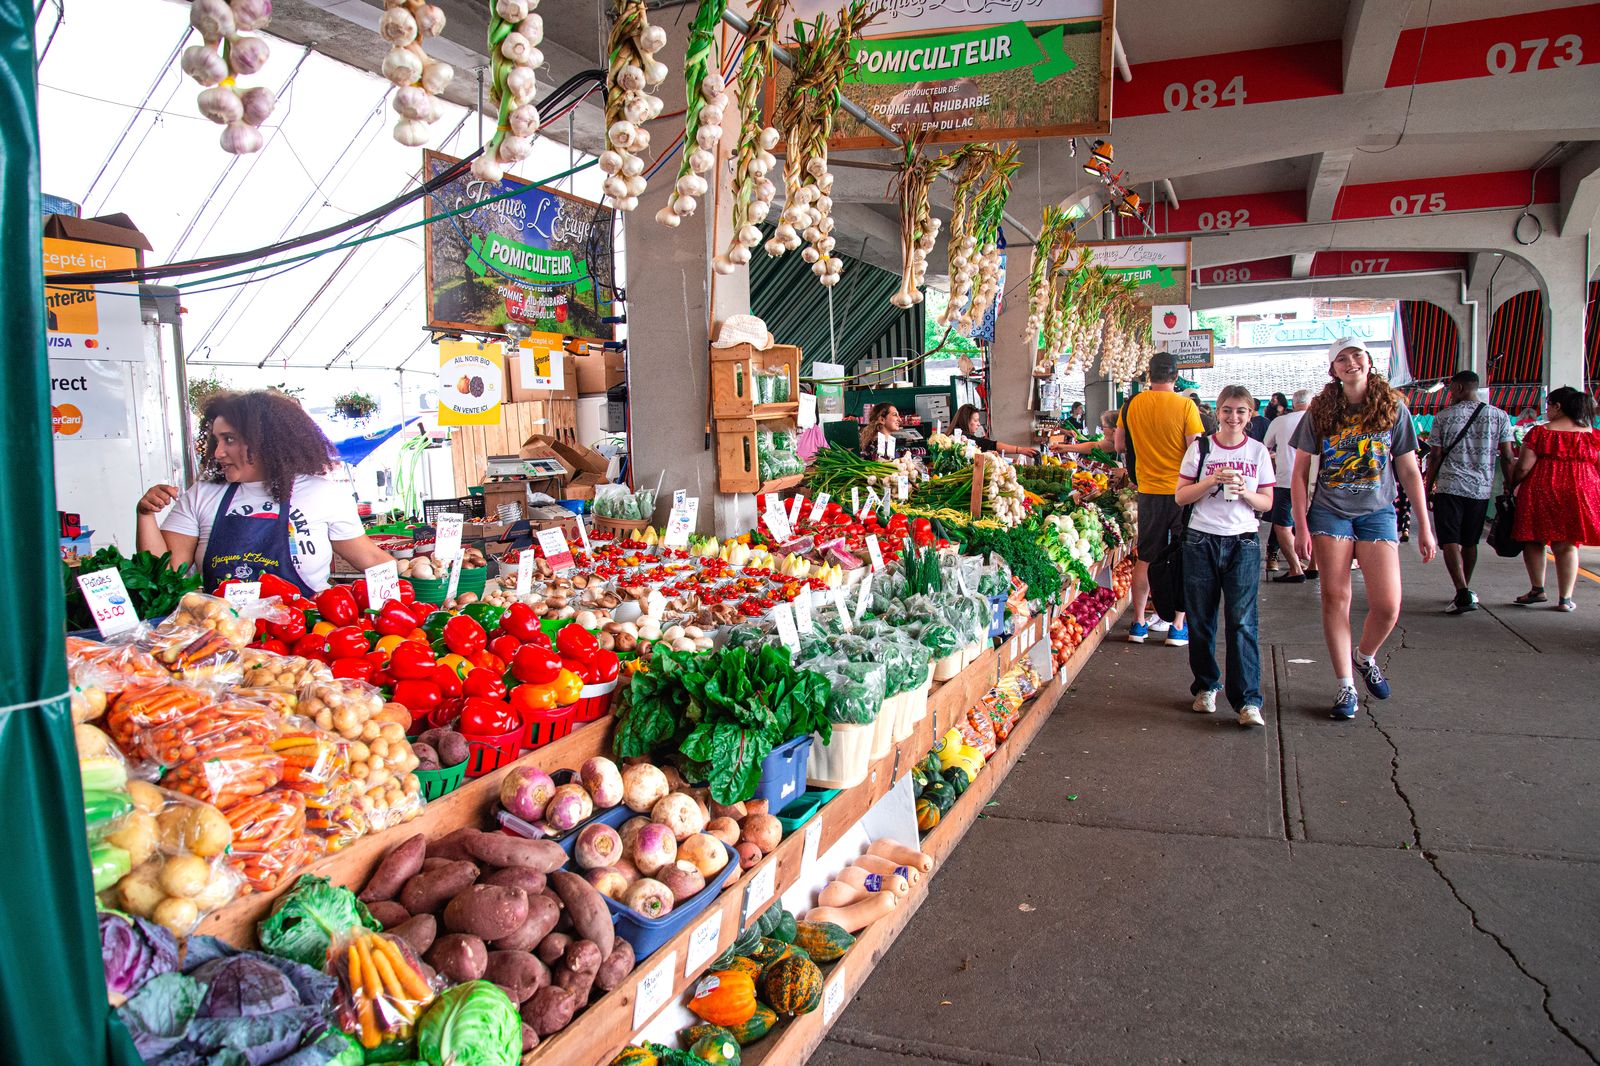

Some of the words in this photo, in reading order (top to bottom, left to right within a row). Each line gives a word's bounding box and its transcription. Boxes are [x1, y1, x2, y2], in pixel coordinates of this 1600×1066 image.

[855, 35, 1012, 74] POMICULTEUR
[1486, 34, 1584, 77] 073
[902, 86, 947, 97] PRODUCTEUR
[1163, 75, 1247, 112] 084
[872, 103, 911, 117] POMME
[912, 102, 931, 114] AIL
[932, 94, 991, 113] RHUBARBE
[940, 119, 954, 130] DU
[955, 116, 974, 128] LAC
[1390, 192, 1447, 216] 075
[1198, 209, 1250, 232] 082
[43, 252, 86, 269] cepté
[90, 254, 107, 269] ici
[489, 239, 573, 275] POMICULTEUR
[1351, 258, 1390, 274] 077
[1212, 268, 1250, 283] 080
[46, 290, 96, 308] nterac
[497, 286, 524, 303] POMME
[512, 306, 520, 315] ST
[47, 337, 73, 348] VISA
[454, 356, 465, 364] AIL
[464, 355, 479, 363] NOIR
[479, 357, 491, 366] BIO
[51, 375, 88, 391] rect
[453, 404, 462, 413] EN
[461, 406, 480, 414] VENTE
[480, 404, 489, 412] ICI
[52, 415, 82, 425] erCard
[289, 504, 310, 537] URF
[299, 540, 316, 555] 10
[211, 555, 241, 568] Jacques
[81, 575, 112, 590] Patates
[96, 605, 125, 621] $5.00
